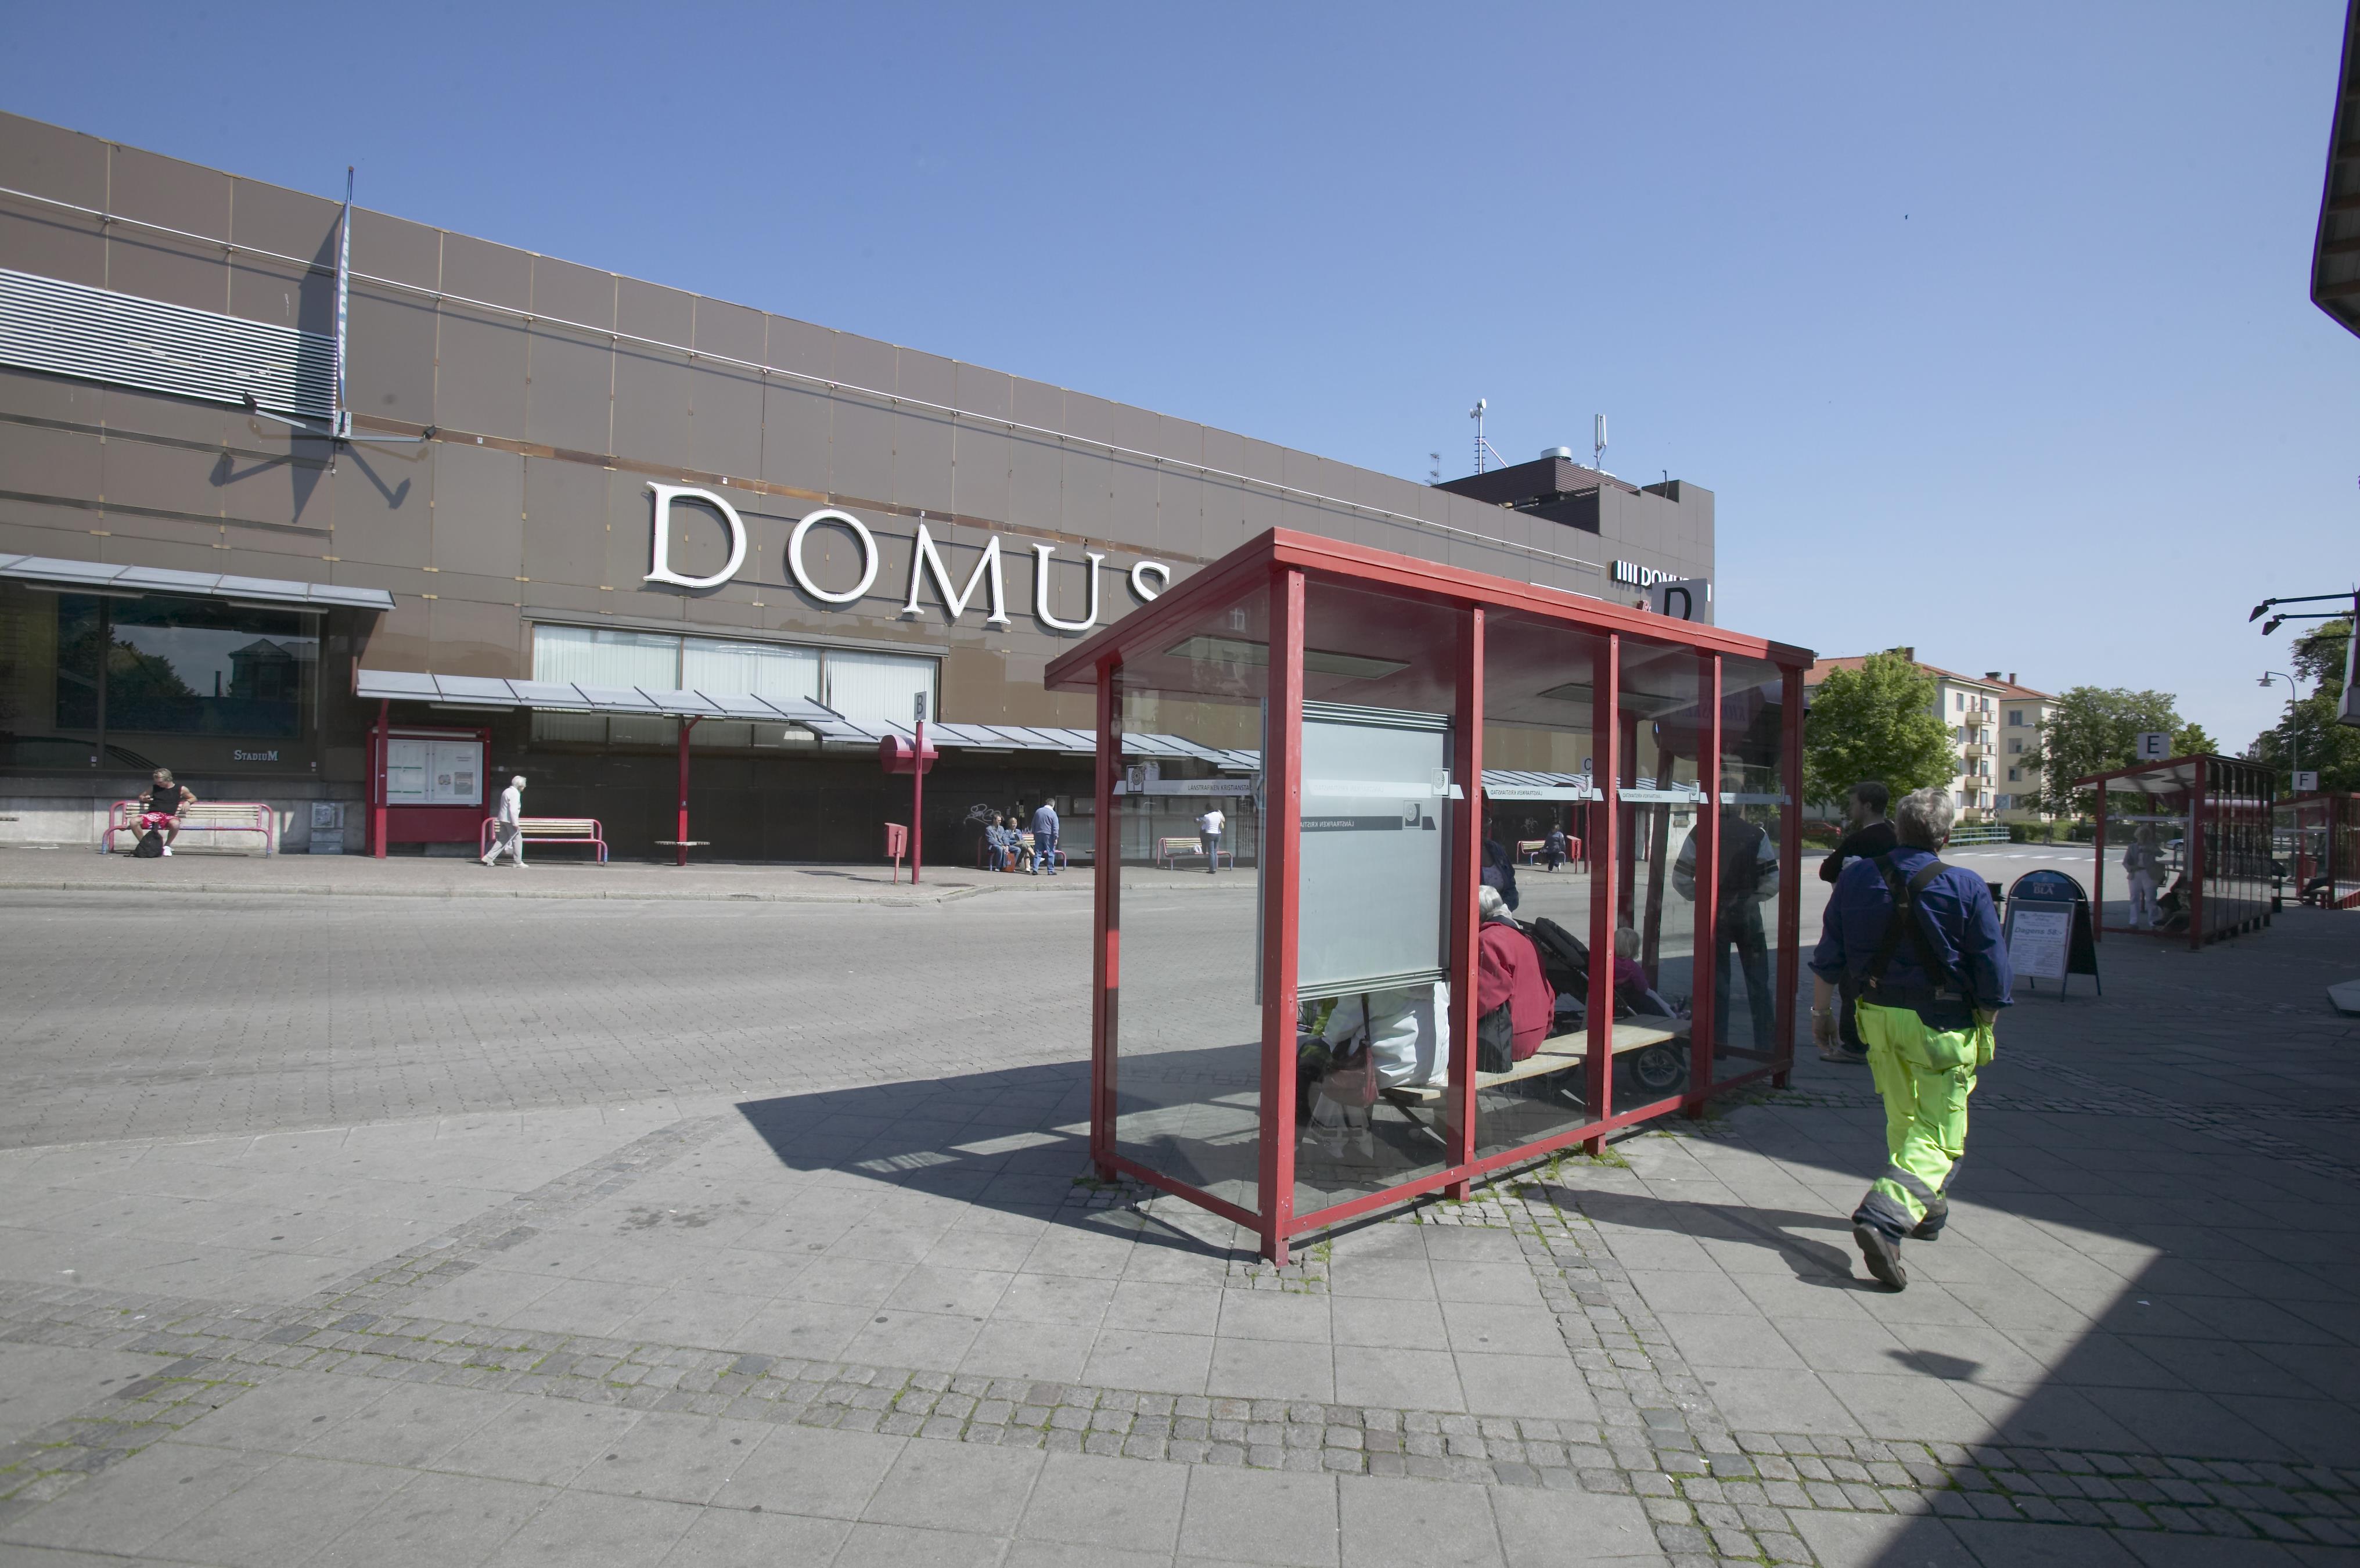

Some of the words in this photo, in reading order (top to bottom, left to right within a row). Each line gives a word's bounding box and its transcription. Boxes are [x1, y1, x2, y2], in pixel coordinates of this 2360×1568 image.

[1663, 587, 1692, 621] D
[917, 695, 923, 714] B
[2147, 735, 2160, 754] E
[1584, 758, 1592, 771] C
[2300, 774, 2309, 786] F
